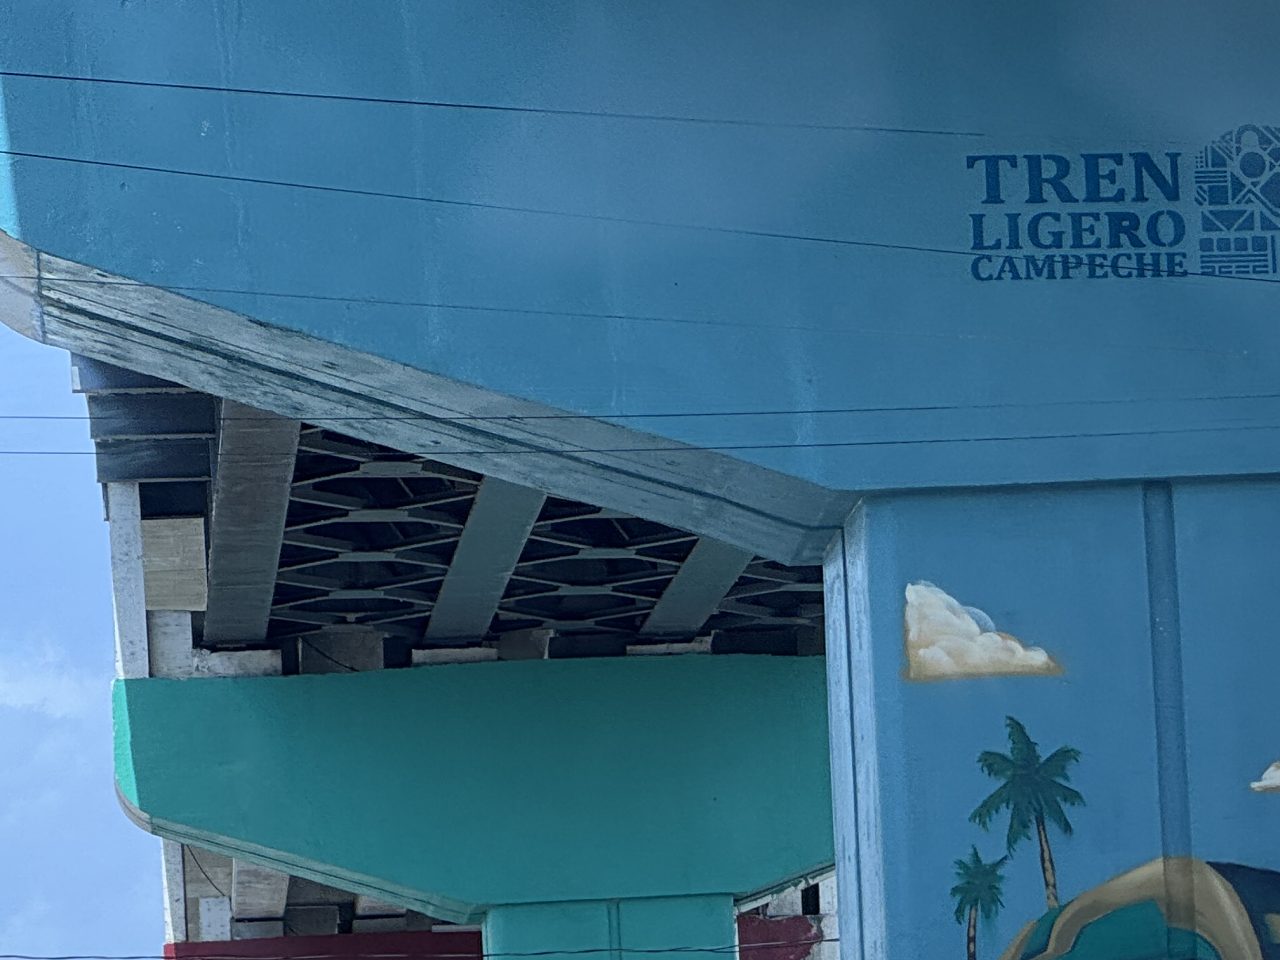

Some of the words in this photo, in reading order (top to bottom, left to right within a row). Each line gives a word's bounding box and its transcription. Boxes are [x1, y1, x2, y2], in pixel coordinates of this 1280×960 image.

[966, 151, 1182, 205] TREN
[970, 210, 1187, 251] LIGERO
[971, 252, 1188, 281] CAMPECHE
